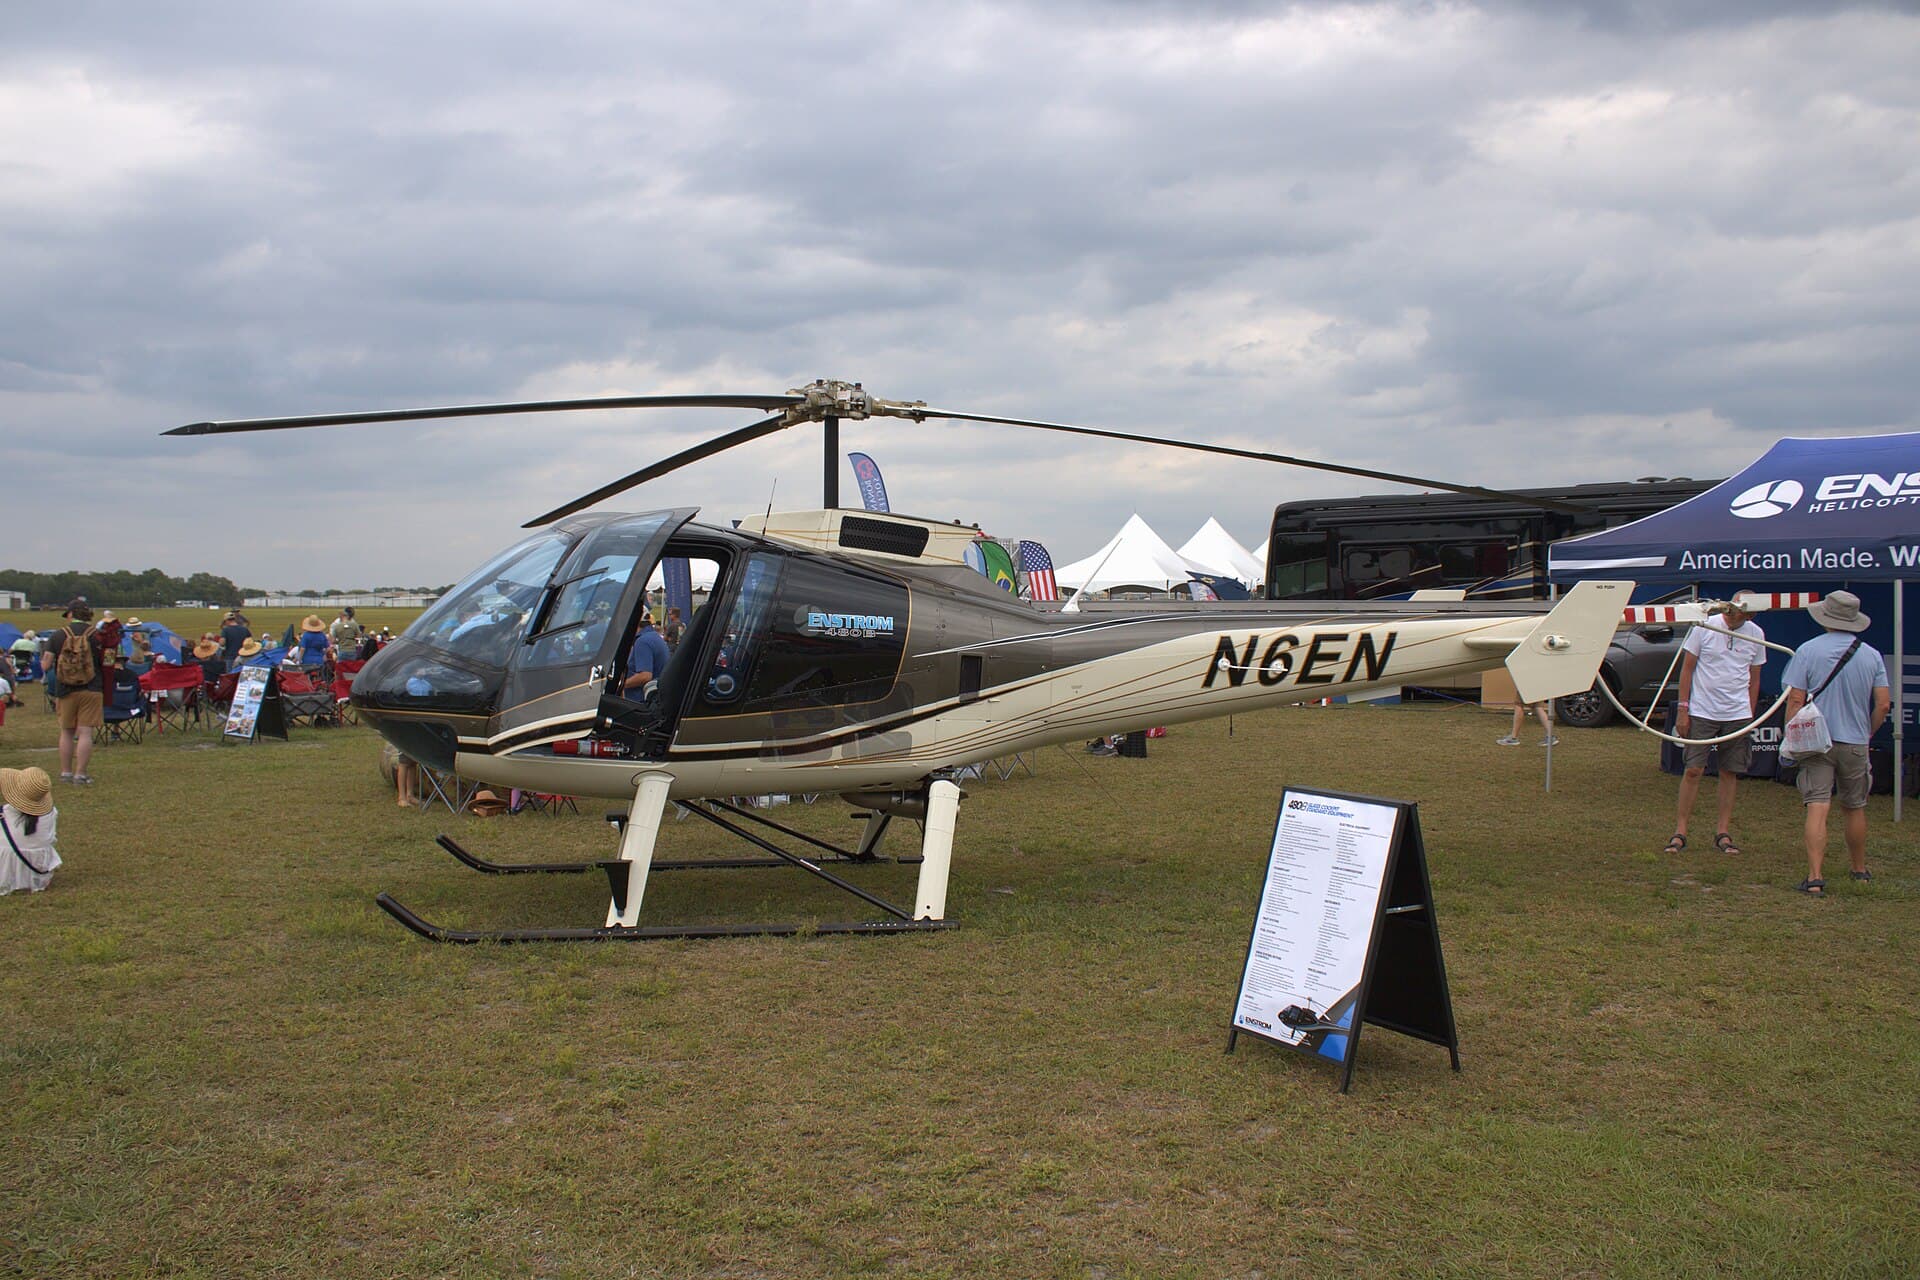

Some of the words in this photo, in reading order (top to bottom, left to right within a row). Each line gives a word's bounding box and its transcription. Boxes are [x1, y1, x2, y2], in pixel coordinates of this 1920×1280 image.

[1679, 549, 1791, 570] American
[1801, 547, 1880, 568] Made.
[1889, 545, 1920, 567] W
[808, 612, 893, 631] ENSTROM
[825, 628, 876, 638] 480B
[1201, 632, 1398, 688] N6EN
[1245, 1017, 1272, 1030] ENSTROM
